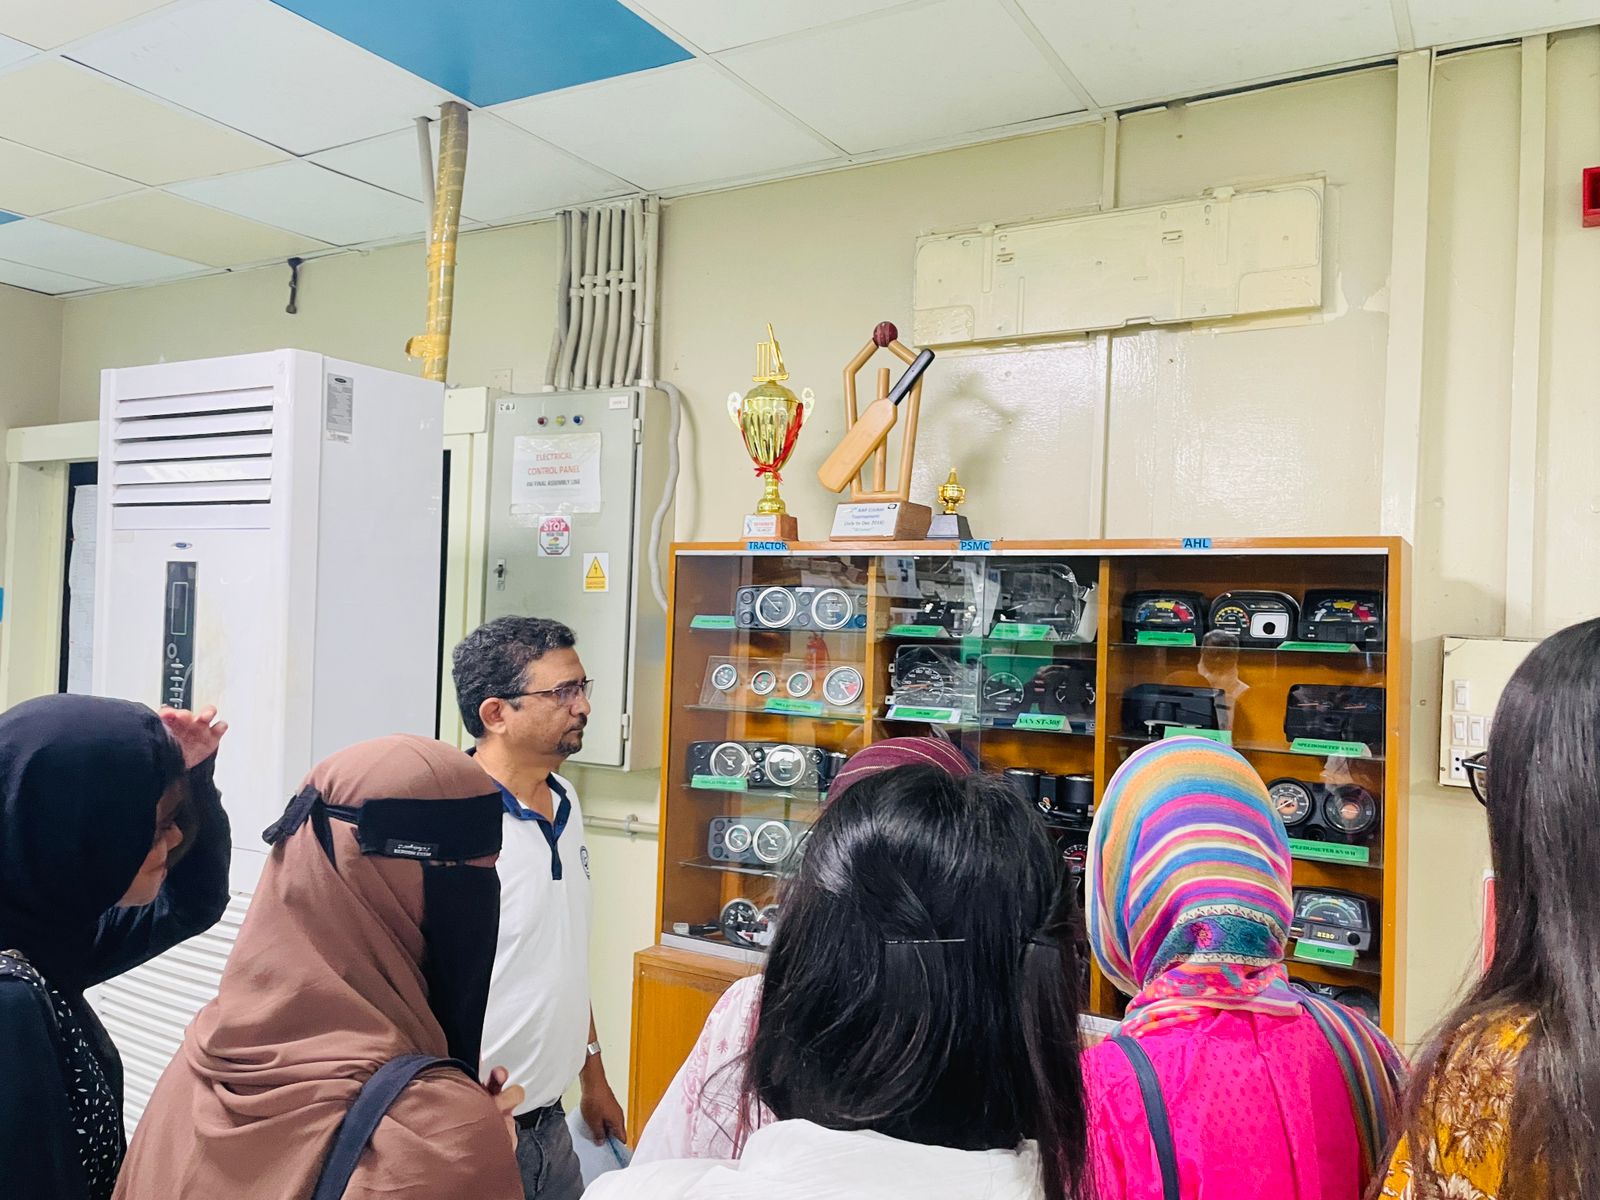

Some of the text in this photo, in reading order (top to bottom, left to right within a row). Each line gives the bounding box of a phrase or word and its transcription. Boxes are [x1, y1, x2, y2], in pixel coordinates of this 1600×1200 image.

[536, 452, 572, 461] ELECTRICAL
[527, 464, 581, 475] CONTROL PANEL
[543, 520, 566, 531] STOP
[748, 541, 787, 550] TRACTOR
[960, 541, 990, 550] PSMC
[1184, 538, 1209, 548] AHL
